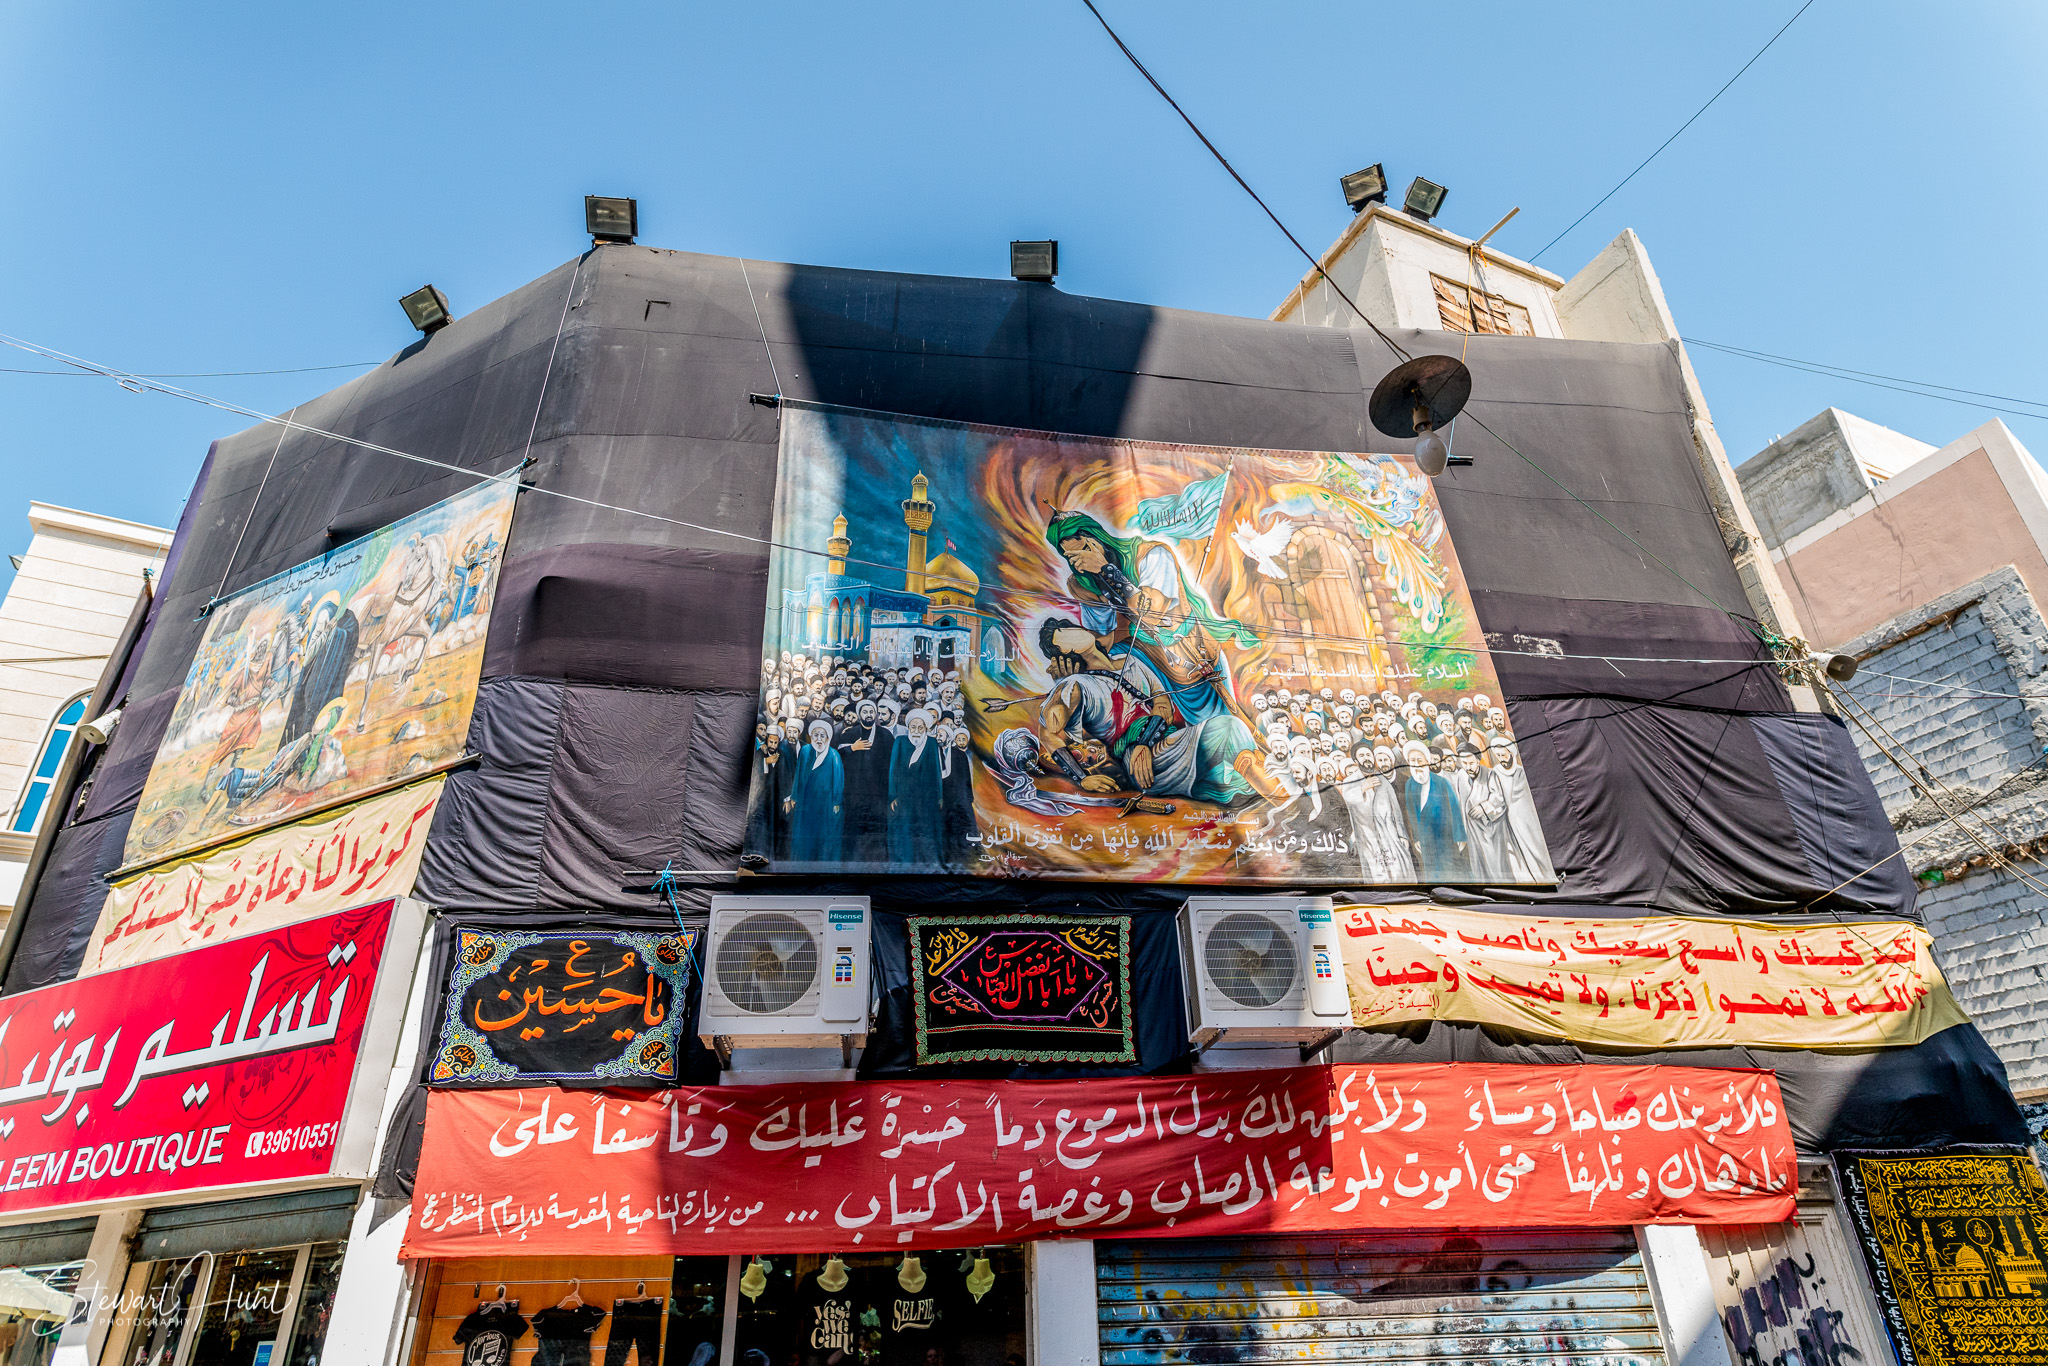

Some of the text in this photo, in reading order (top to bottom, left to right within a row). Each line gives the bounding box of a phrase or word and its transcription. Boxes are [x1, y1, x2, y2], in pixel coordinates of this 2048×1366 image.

[1383, 662, 1422, 682] عليك
[1426, 660, 1469, 685] السلام
[0, 938, 358, 1142] تسليم بوتي
[67, 1122, 232, 1184] BOUTIQUE
[261, 1121, 339, 1156] 39610551
[546, 1190, 613, 1234] المقدسة
[682, 1189, 730, 1235] زيارة
[728, 1200, 765, 1227] من
[892, 1299, 935, 1332] SELFIE
